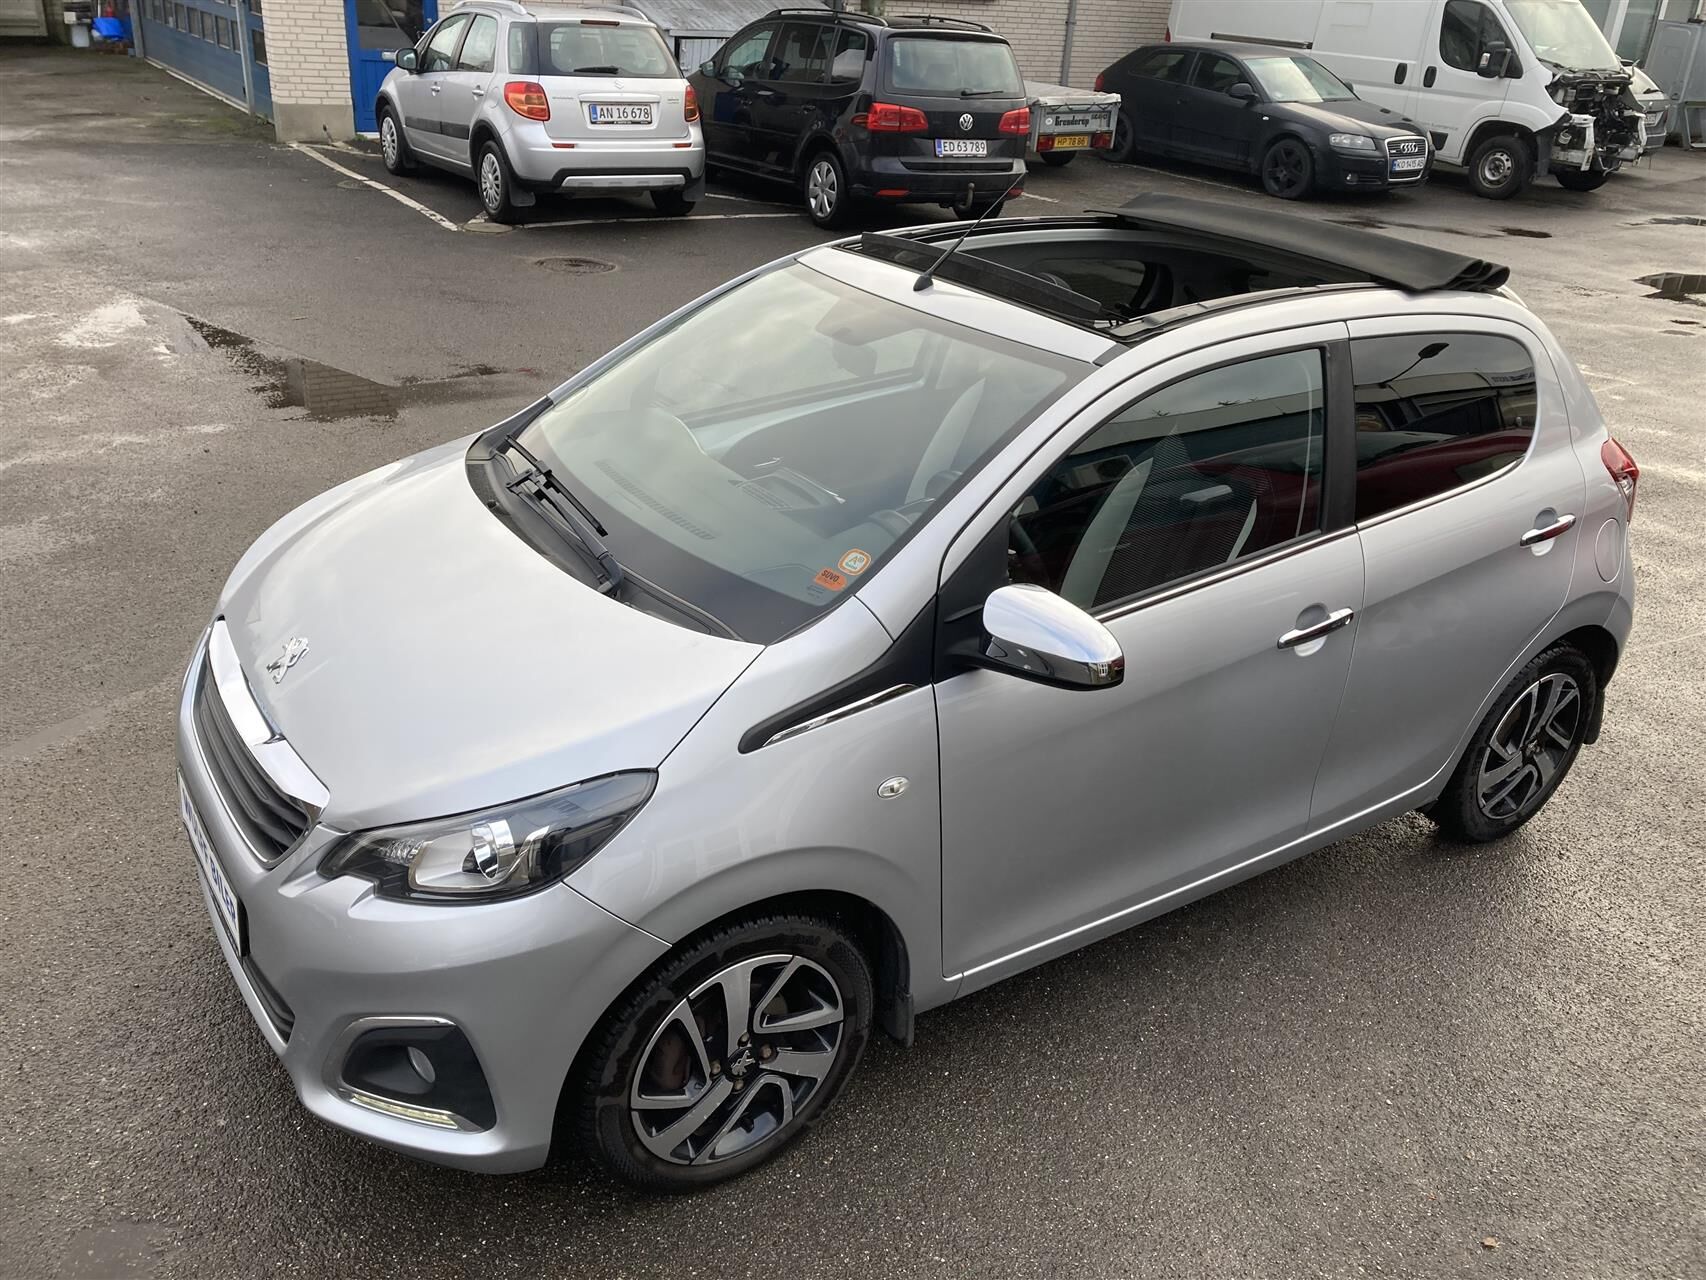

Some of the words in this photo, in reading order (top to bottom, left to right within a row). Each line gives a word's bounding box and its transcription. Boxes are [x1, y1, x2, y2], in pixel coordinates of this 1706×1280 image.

[599, 107, 614, 119] AN
[616, 107, 629, 119] 16
[631, 107, 649, 119] 678
[943, 141, 955, 152] ED
[957, 141, 968, 152] 63
[969, 141, 986, 152] 789
[209, 855, 237, 929] BILER
